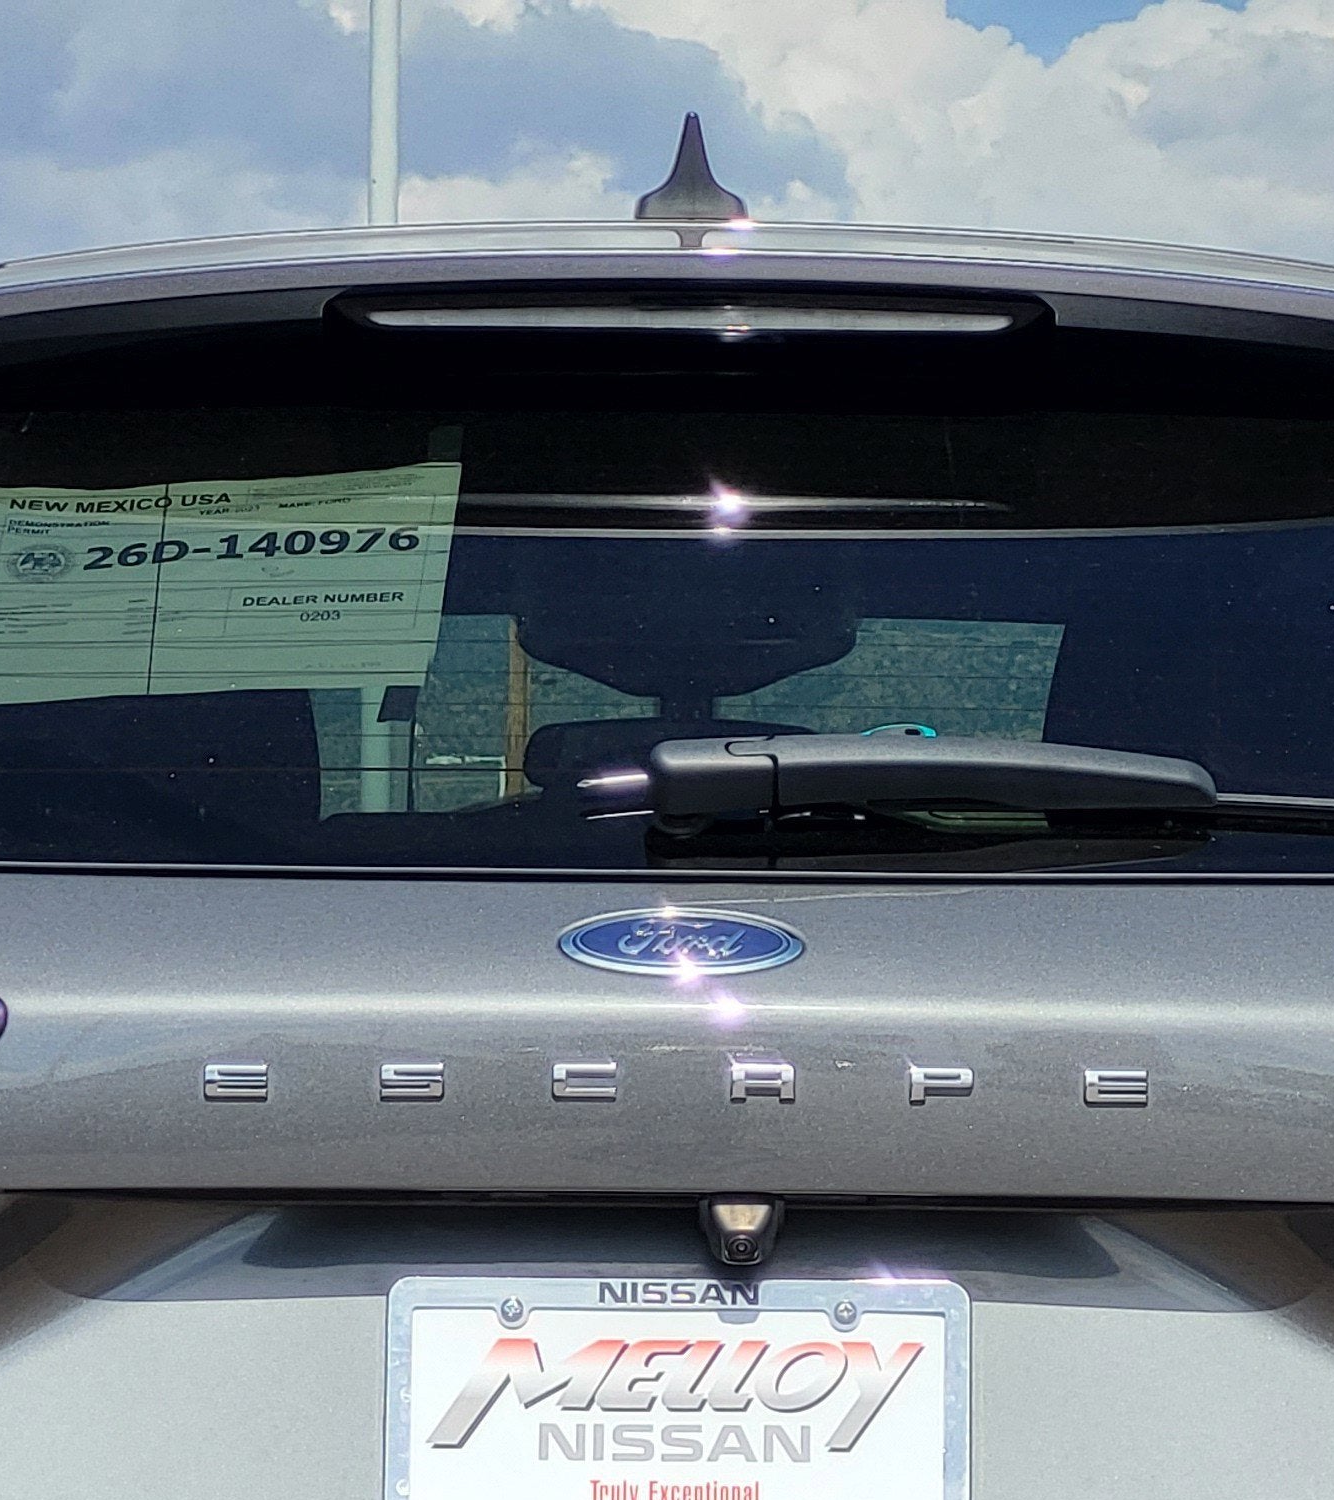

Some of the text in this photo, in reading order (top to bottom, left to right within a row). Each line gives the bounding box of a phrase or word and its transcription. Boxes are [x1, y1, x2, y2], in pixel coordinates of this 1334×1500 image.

[9, 492, 231, 514] NEW MEXICO USA
[83, 526, 419, 571] 26D-140976
[242, 591, 404, 607] DEALER NUMBER
[300, 610, 341, 622] 0203
[618, 917, 745, 960] Ford
[202, 1060, 1150, 1107] ESCAPE
[598, 1281, 760, 1307] NISSAN
[425, 1337, 926, 1453] MELLOY
[538, 1423, 811, 1463] NISSAN
